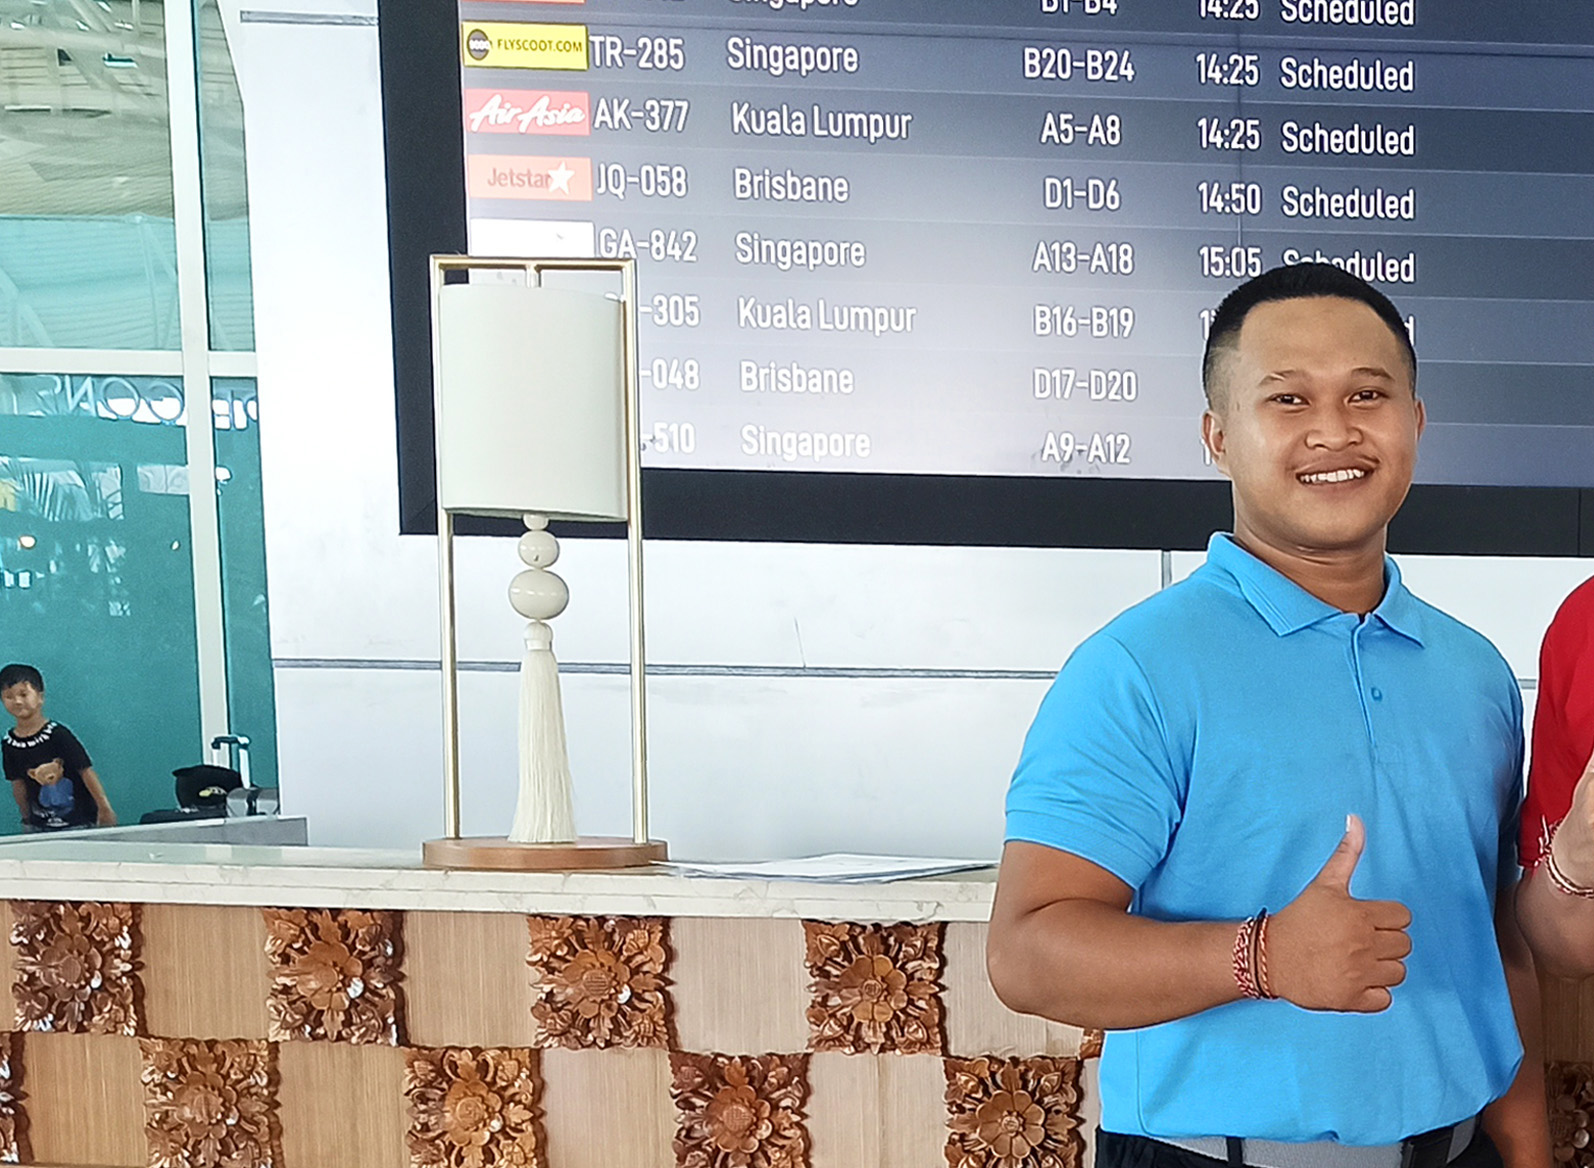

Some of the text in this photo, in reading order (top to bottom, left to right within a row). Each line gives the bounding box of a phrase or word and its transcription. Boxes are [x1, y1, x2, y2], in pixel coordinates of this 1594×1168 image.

[1199, 0, 1261, 20] 14:25
[1281, 0, 1415, 26] Scheduled
[497, 38, 583, 52] FLYSCOOT.COM
[589, 36, 1414, 92] TR-285 Singapore B20-B24 14:25 Scheduled
[593, 98, 1415, 156] AK-377 Kuala Lumpur A5-A8 14:25 Scheduled
[487, 168, 551, 188] Jetstar
[596, 162, 1415, 220] JQ-058 Brisbane D1-D6 14:50 Scheduled
[599, 228, 1415, 283] GA-842 Singapore A13-A18 15:05 Sduled
[639, 294, 1136, 339] -305 Kuala Lumpur B16-B19
[641, 358, 1138, 402] -048 Brisbane D17-D20
[642, 421, 1131, 465] -510 Singapore A9-A12
